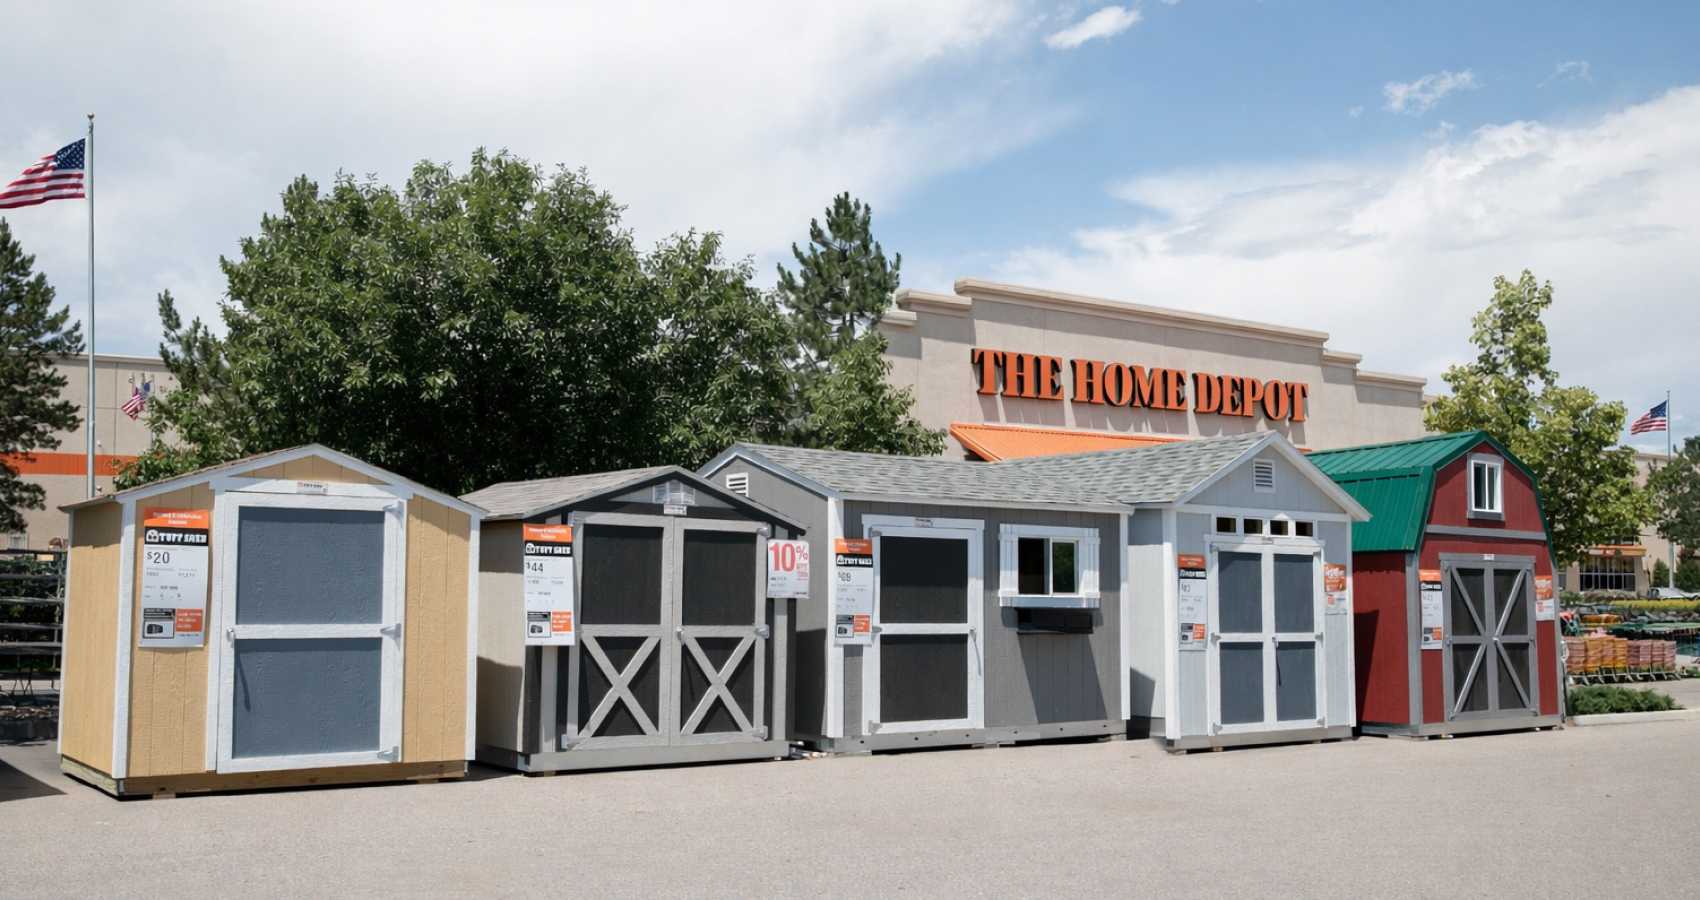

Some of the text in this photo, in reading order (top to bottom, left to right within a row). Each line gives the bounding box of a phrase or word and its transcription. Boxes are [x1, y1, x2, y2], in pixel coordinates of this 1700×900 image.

[971, 348, 1310, 423] THE HOME DEPOT
[146, 551, 170, 564] $20
